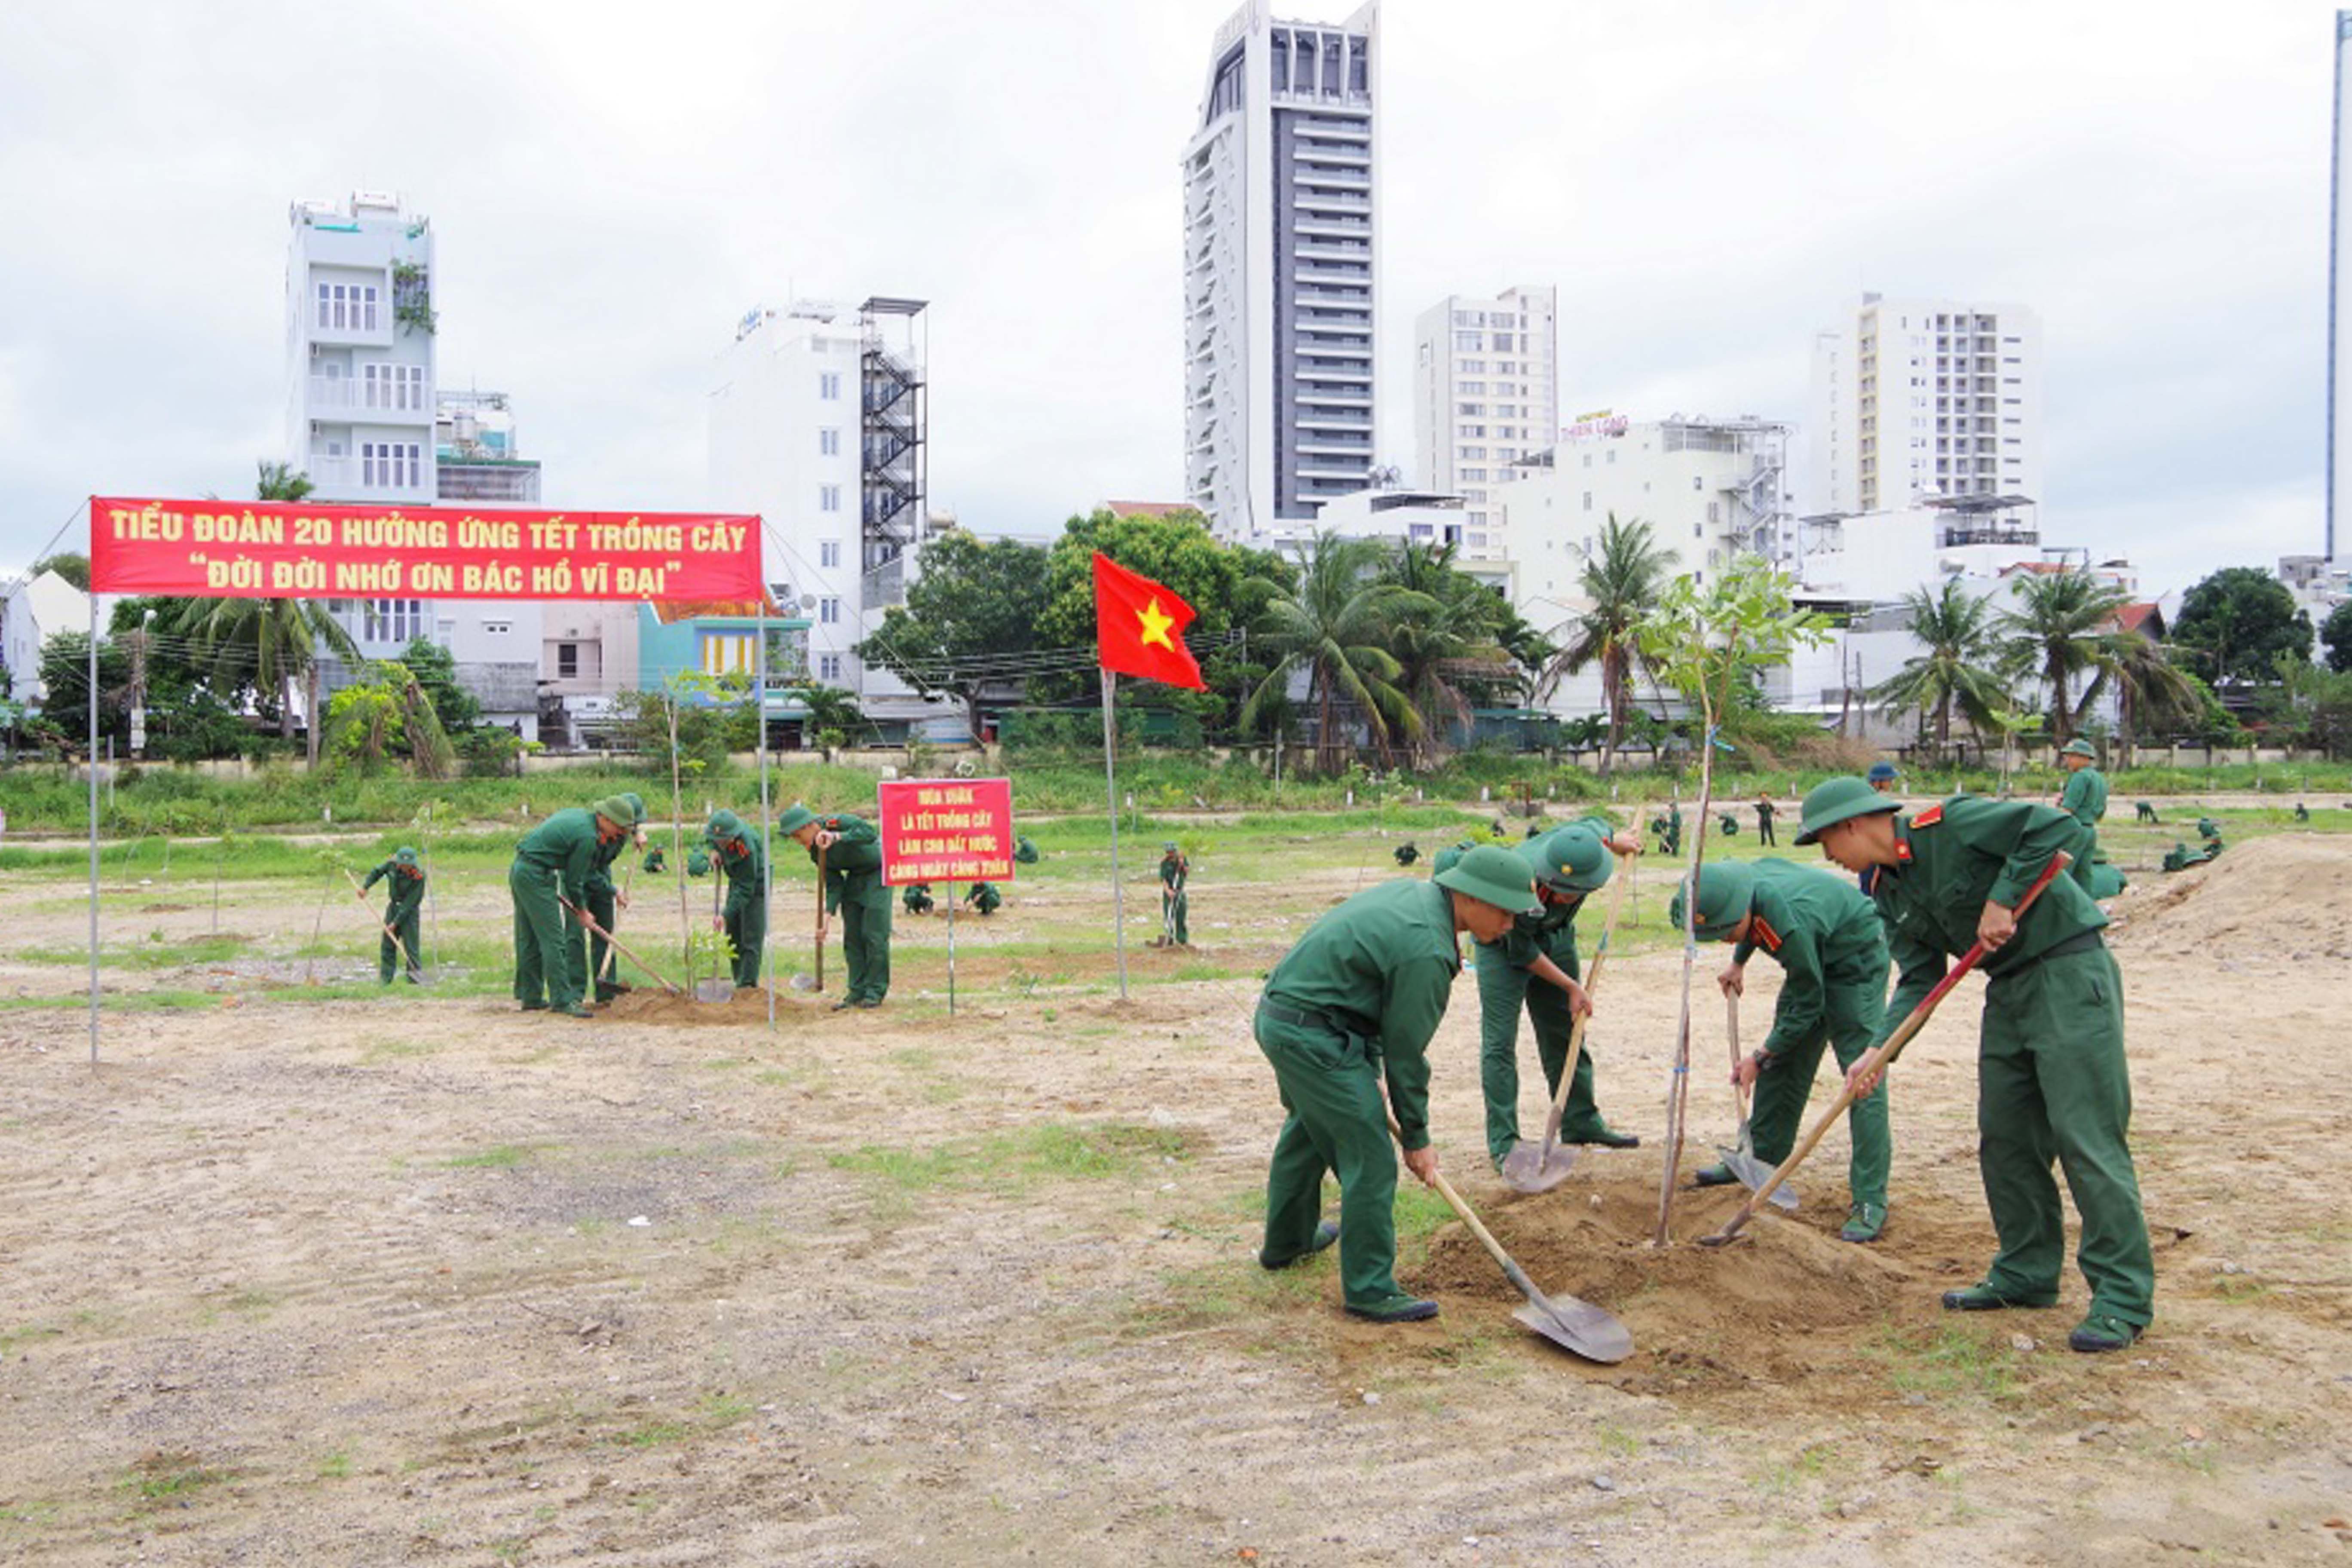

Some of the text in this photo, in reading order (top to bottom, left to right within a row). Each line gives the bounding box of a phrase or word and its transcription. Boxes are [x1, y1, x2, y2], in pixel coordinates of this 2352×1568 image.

[110, 501, 183, 541] TIỂU
[193, 510, 284, 543] ĐOÀN
[294, 518, 332, 545] 20
[342, 511, 448, 548] HƯỞNG
[458, 516, 520, 548] ỨNG
[528, 515, 579, 549] TẾT
[692, 522, 746, 552] CÂY
[273, 556, 326, 589] ĐỜI
[336, 558, 402, 591] NHỚ
[412, 562, 453, 592] ƠN
[463, 560, 523, 592] BÁC
[532, 558, 572, 593] HỒ
[581, 562, 609, 594] VĨ
